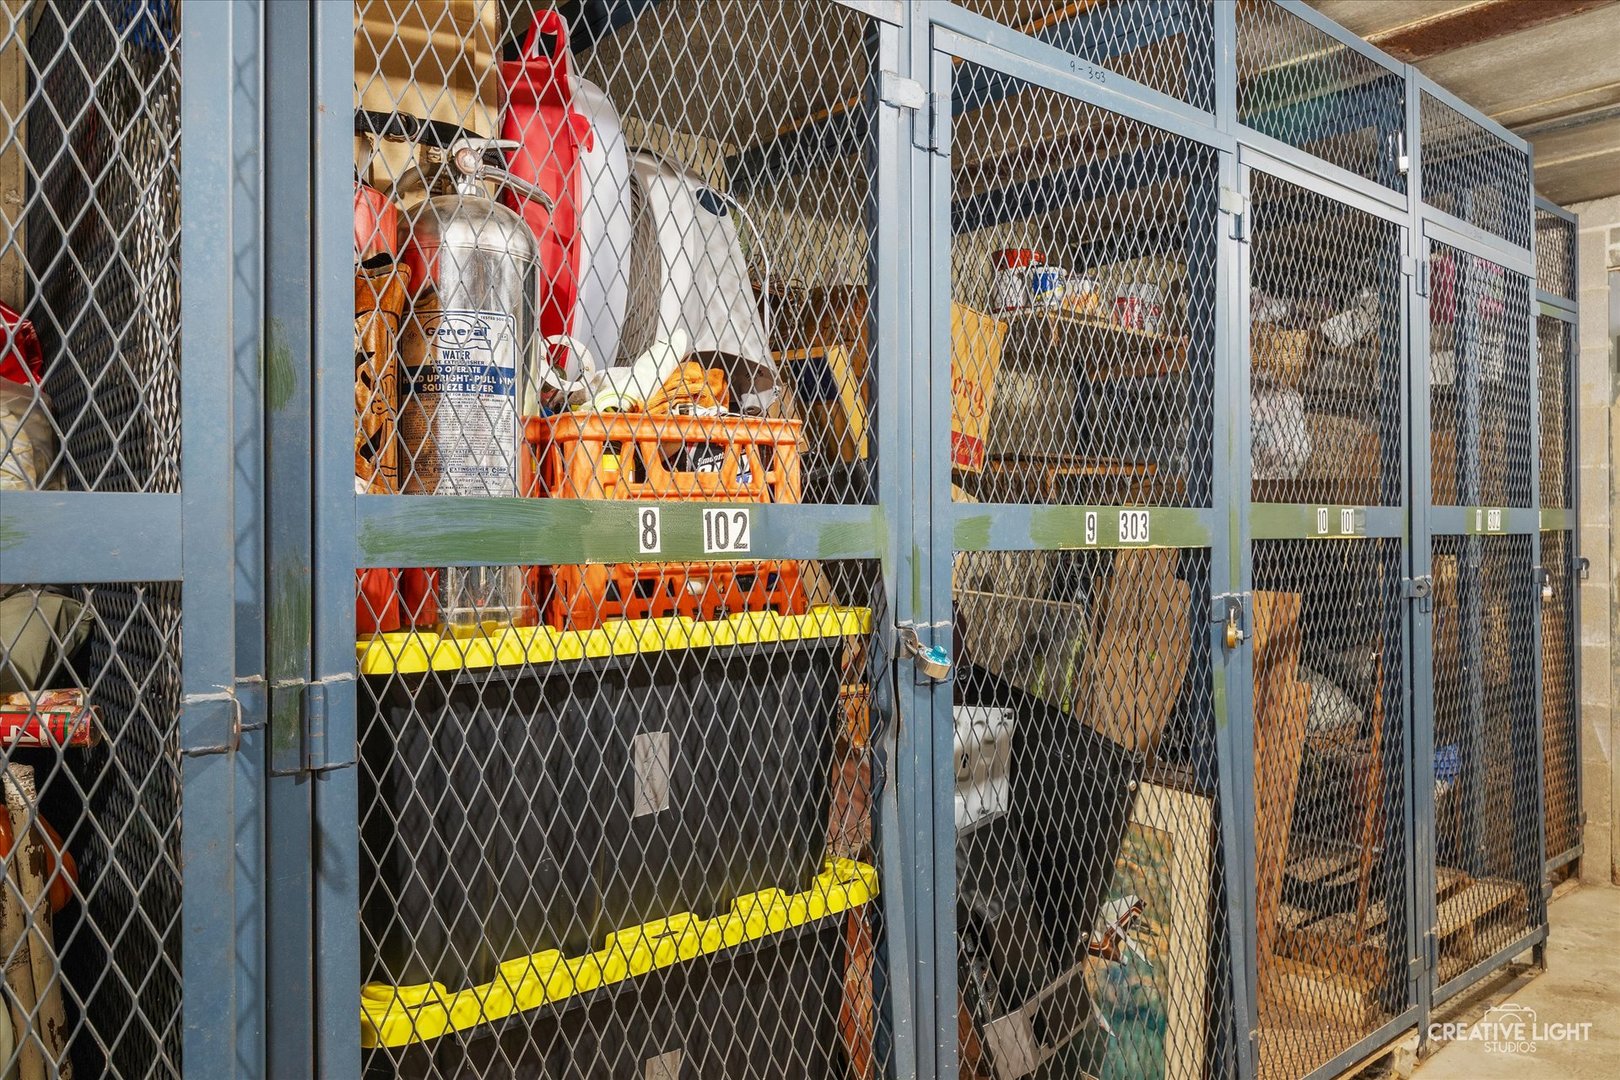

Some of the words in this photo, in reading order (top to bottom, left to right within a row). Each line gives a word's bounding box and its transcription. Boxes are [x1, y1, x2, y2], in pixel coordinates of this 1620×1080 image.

[425, 326, 488, 337] General
[442, 350, 471, 360] WATER
[403, 374, 424, 383] HD
[1087, 513, 1096, 543] 9
[1120, 512, 1148, 540] 303
[1318, 510, 1327, 532] 10
[641, 509, 658, 550] 8
[704, 511, 748, 551] 102
